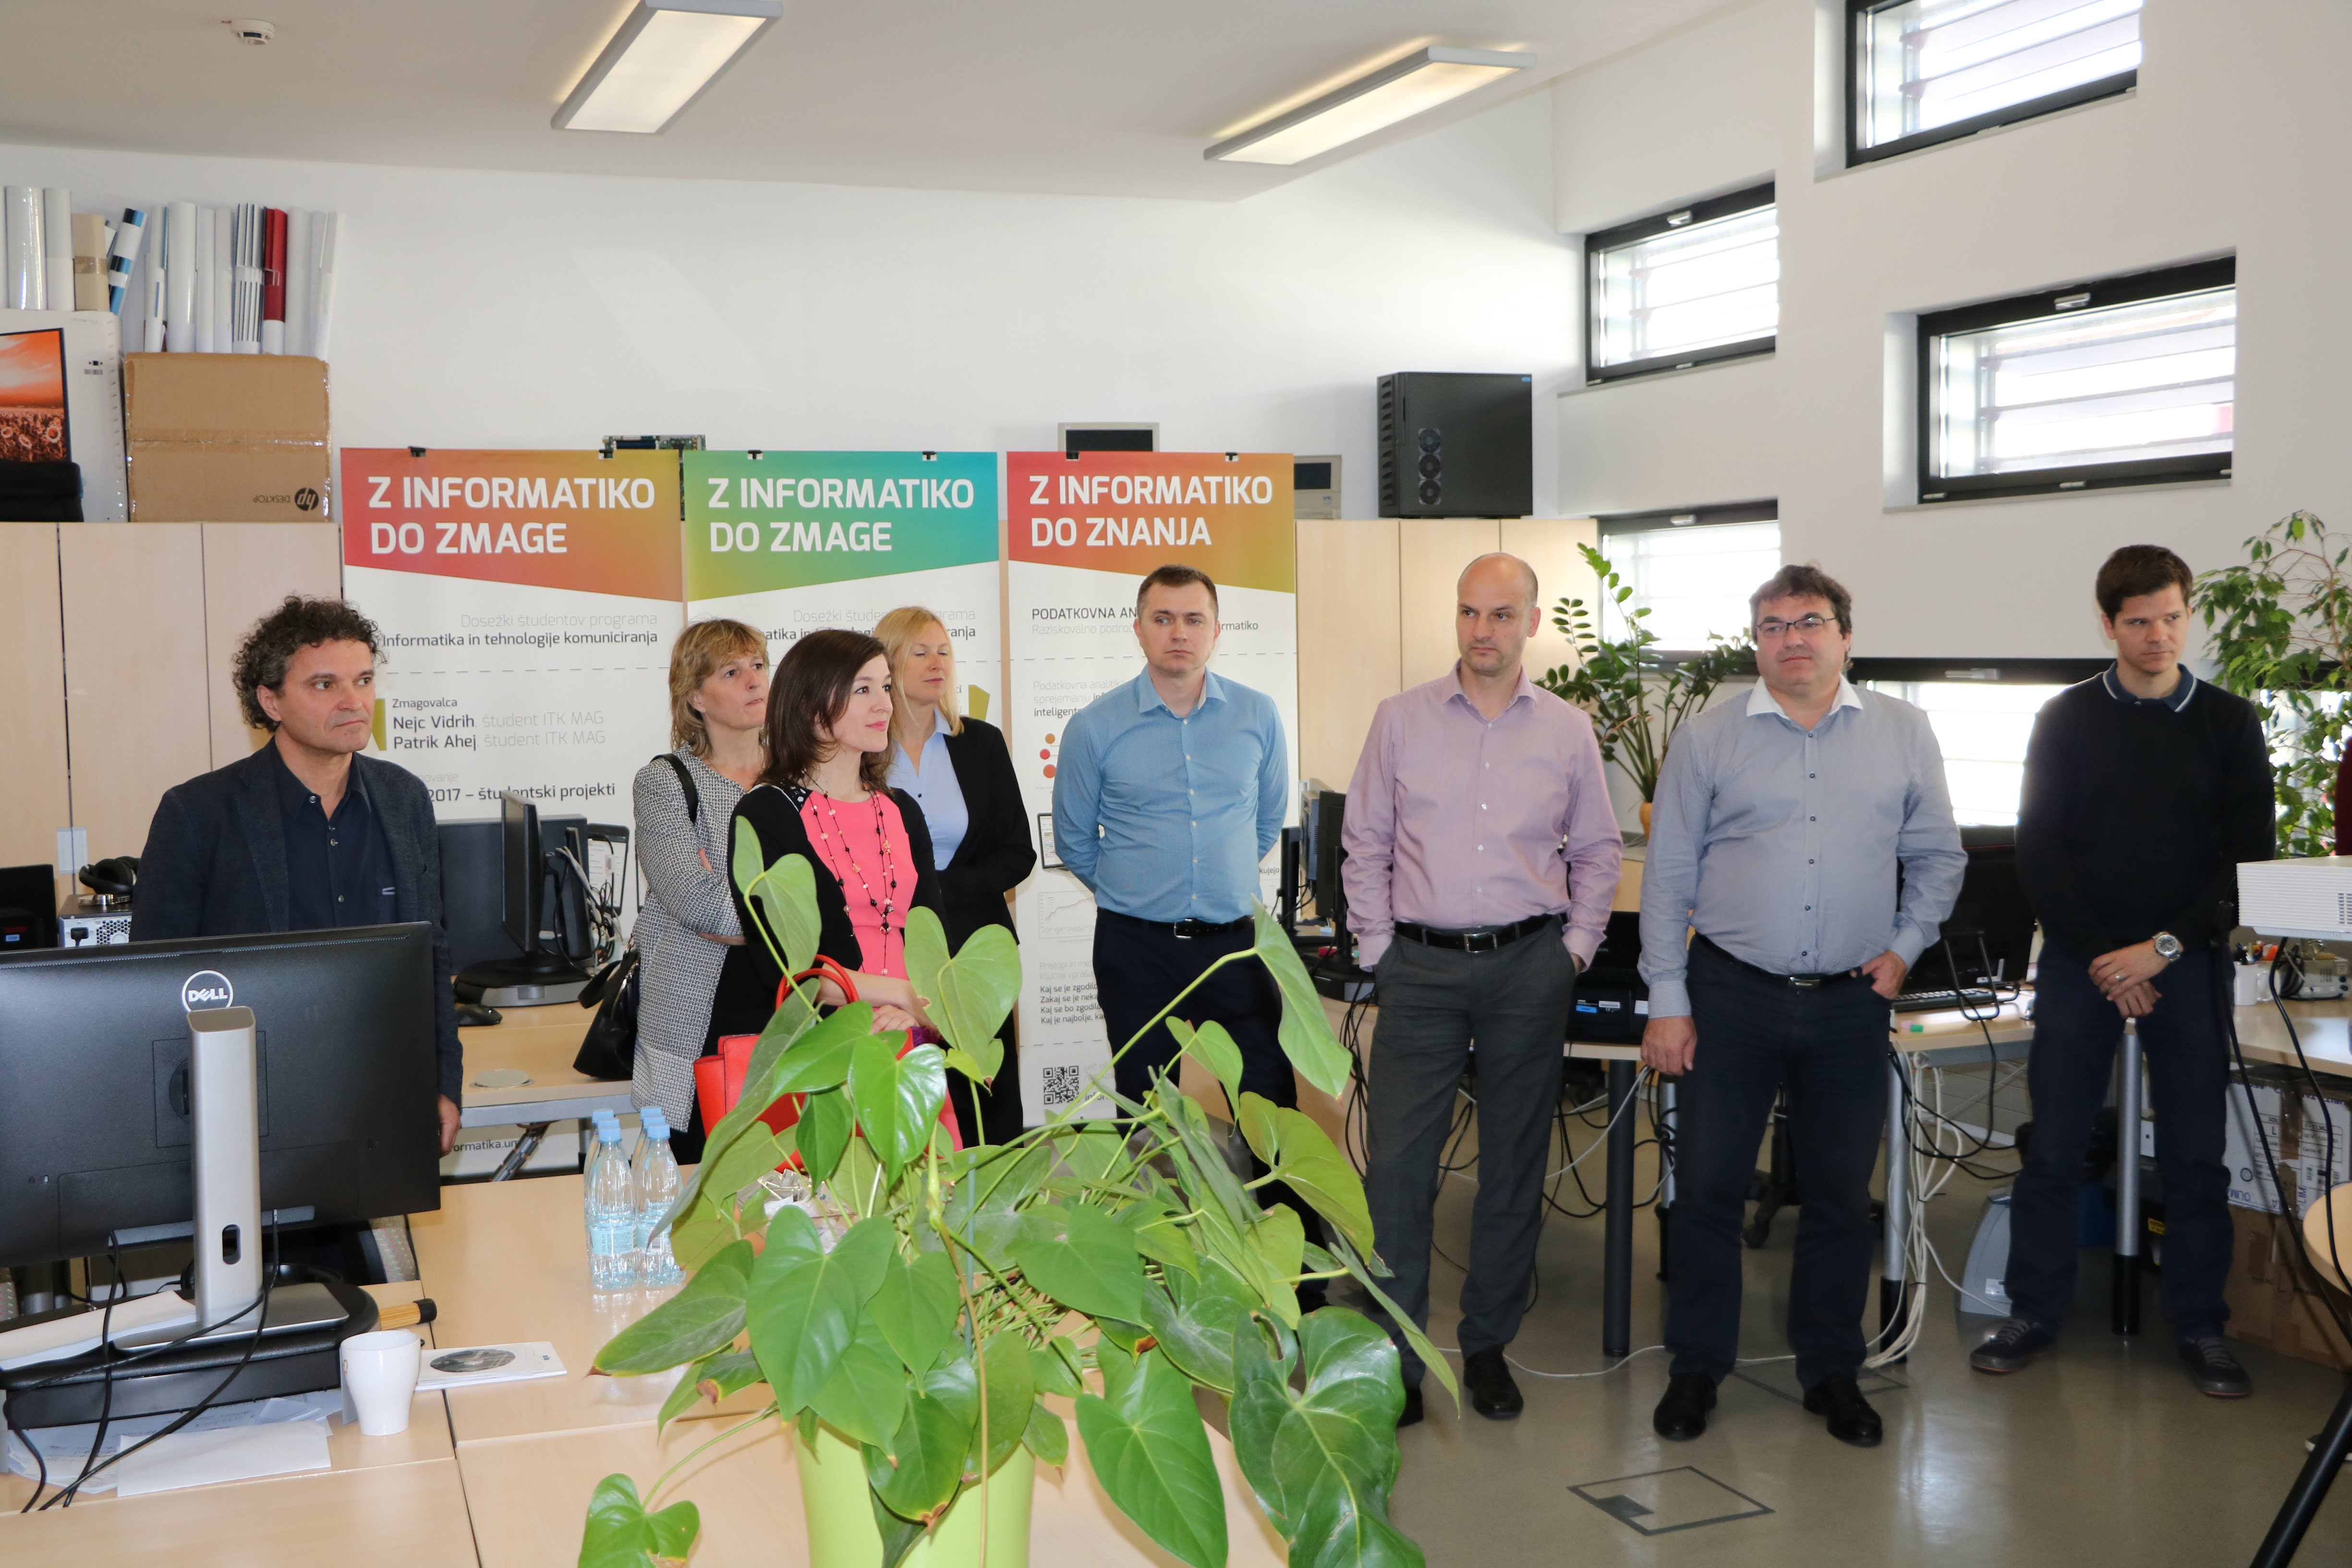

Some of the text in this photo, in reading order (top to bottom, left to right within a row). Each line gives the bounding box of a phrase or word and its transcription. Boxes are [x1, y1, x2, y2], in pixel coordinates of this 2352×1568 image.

[368, 476, 655, 509] Z INFORMATIKO
[708, 478, 974, 509] Z INFORMATIKO
[1029, 476, 1273, 504] Z INFORMATIKO
[253, 495, 291, 503] DESKTOP
[371, 523, 567, 554] DO ZMAGE
[710, 522, 892, 551] DO ZMAGE
[1031, 517, 1212, 547] DO ZNANJA
[461, 613, 657, 628] Dosežki študentov programa
[794, 609, 841, 621] Dosežki
[1032, 608, 1115, 620] PODATKOVNA
[1032, 623, 1096, 634] Raziskovalno
[1221, 620, 1258, 630] rmatiko
[383, 631, 657, 647] Informatika in tehnologije komuniciranja
[1033, 681, 1087, 690] Podatkovna
[392, 698, 458, 710] Zmagovalca
[393, 716, 425, 733] Nejc
[482, 713, 537, 727] študent
[544, 712, 566, 726] ITK
[571, 711, 604, 724] MAG
[394, 736, 438, 749] Patrik
[484, 732, 540, 746] študent
[546, 732, 568, 745] ITK
[573, 730, 605, 744] MAG
[561, 784, 615, 802] projekti
[188, 987, 228, 1002] DELL
[1065, 985, 1070, 993] je
[1040, 996, 1060, 1004] Zakaj
